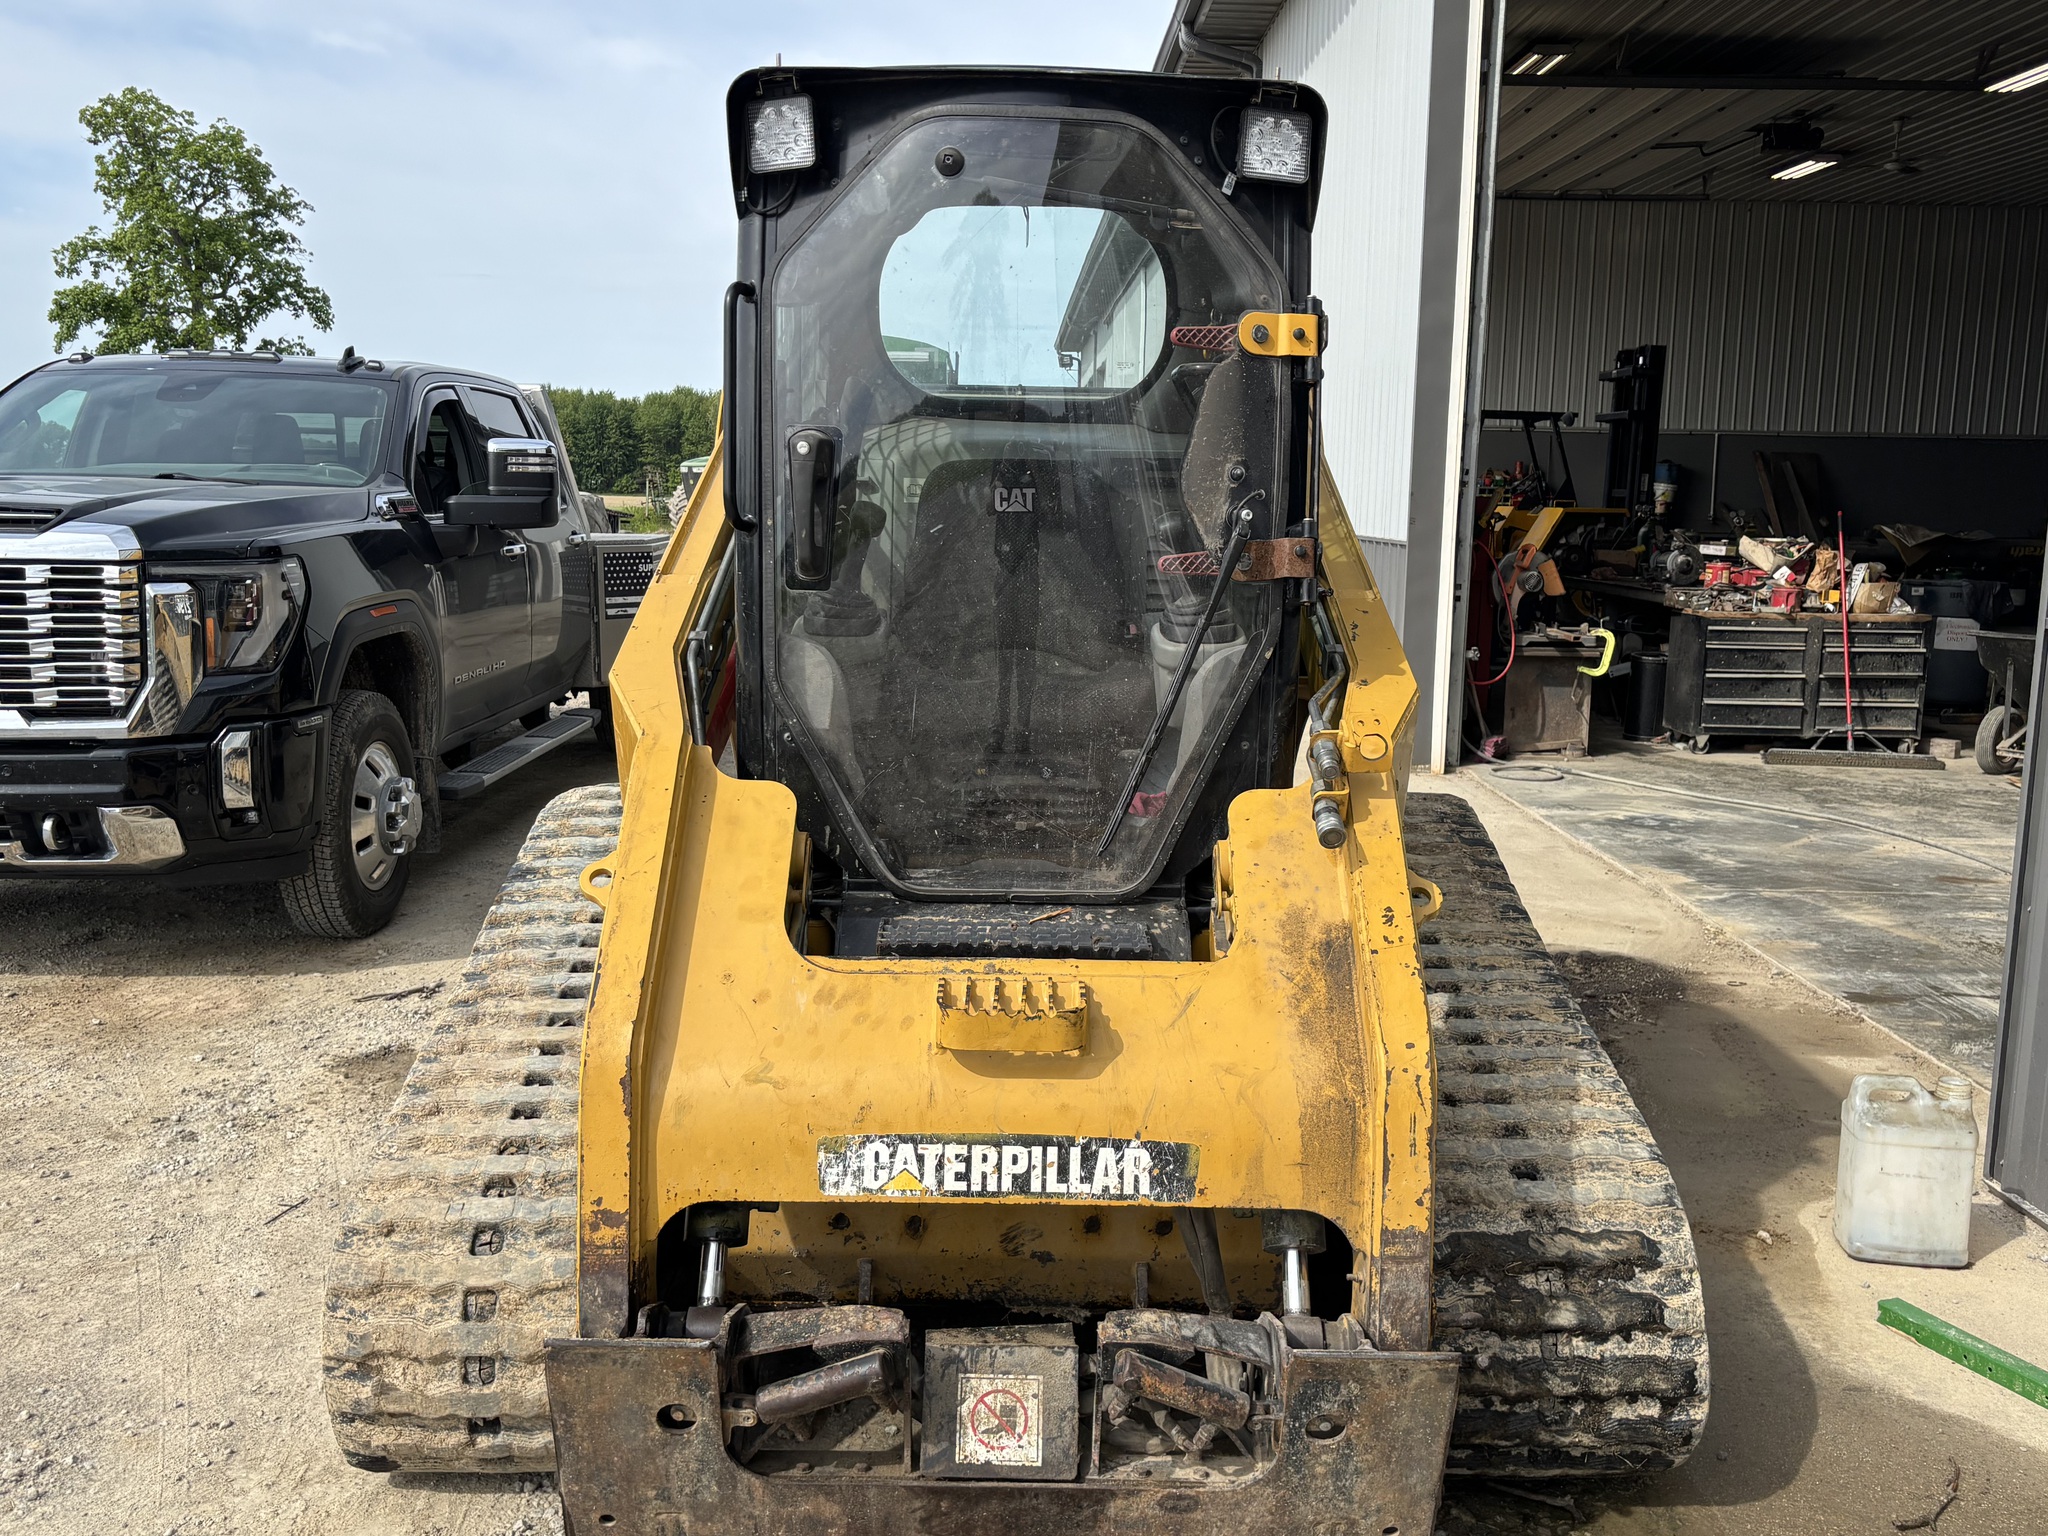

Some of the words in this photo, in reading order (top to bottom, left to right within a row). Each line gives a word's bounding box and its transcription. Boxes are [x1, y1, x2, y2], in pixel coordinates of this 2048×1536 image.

[994, 487, 1036, 512] CAT
[453, 665, 492, 685] DENALI
[492, 659, 507, 671] HD
[863, 1142, 1153, 1196] CATERPILLAR
